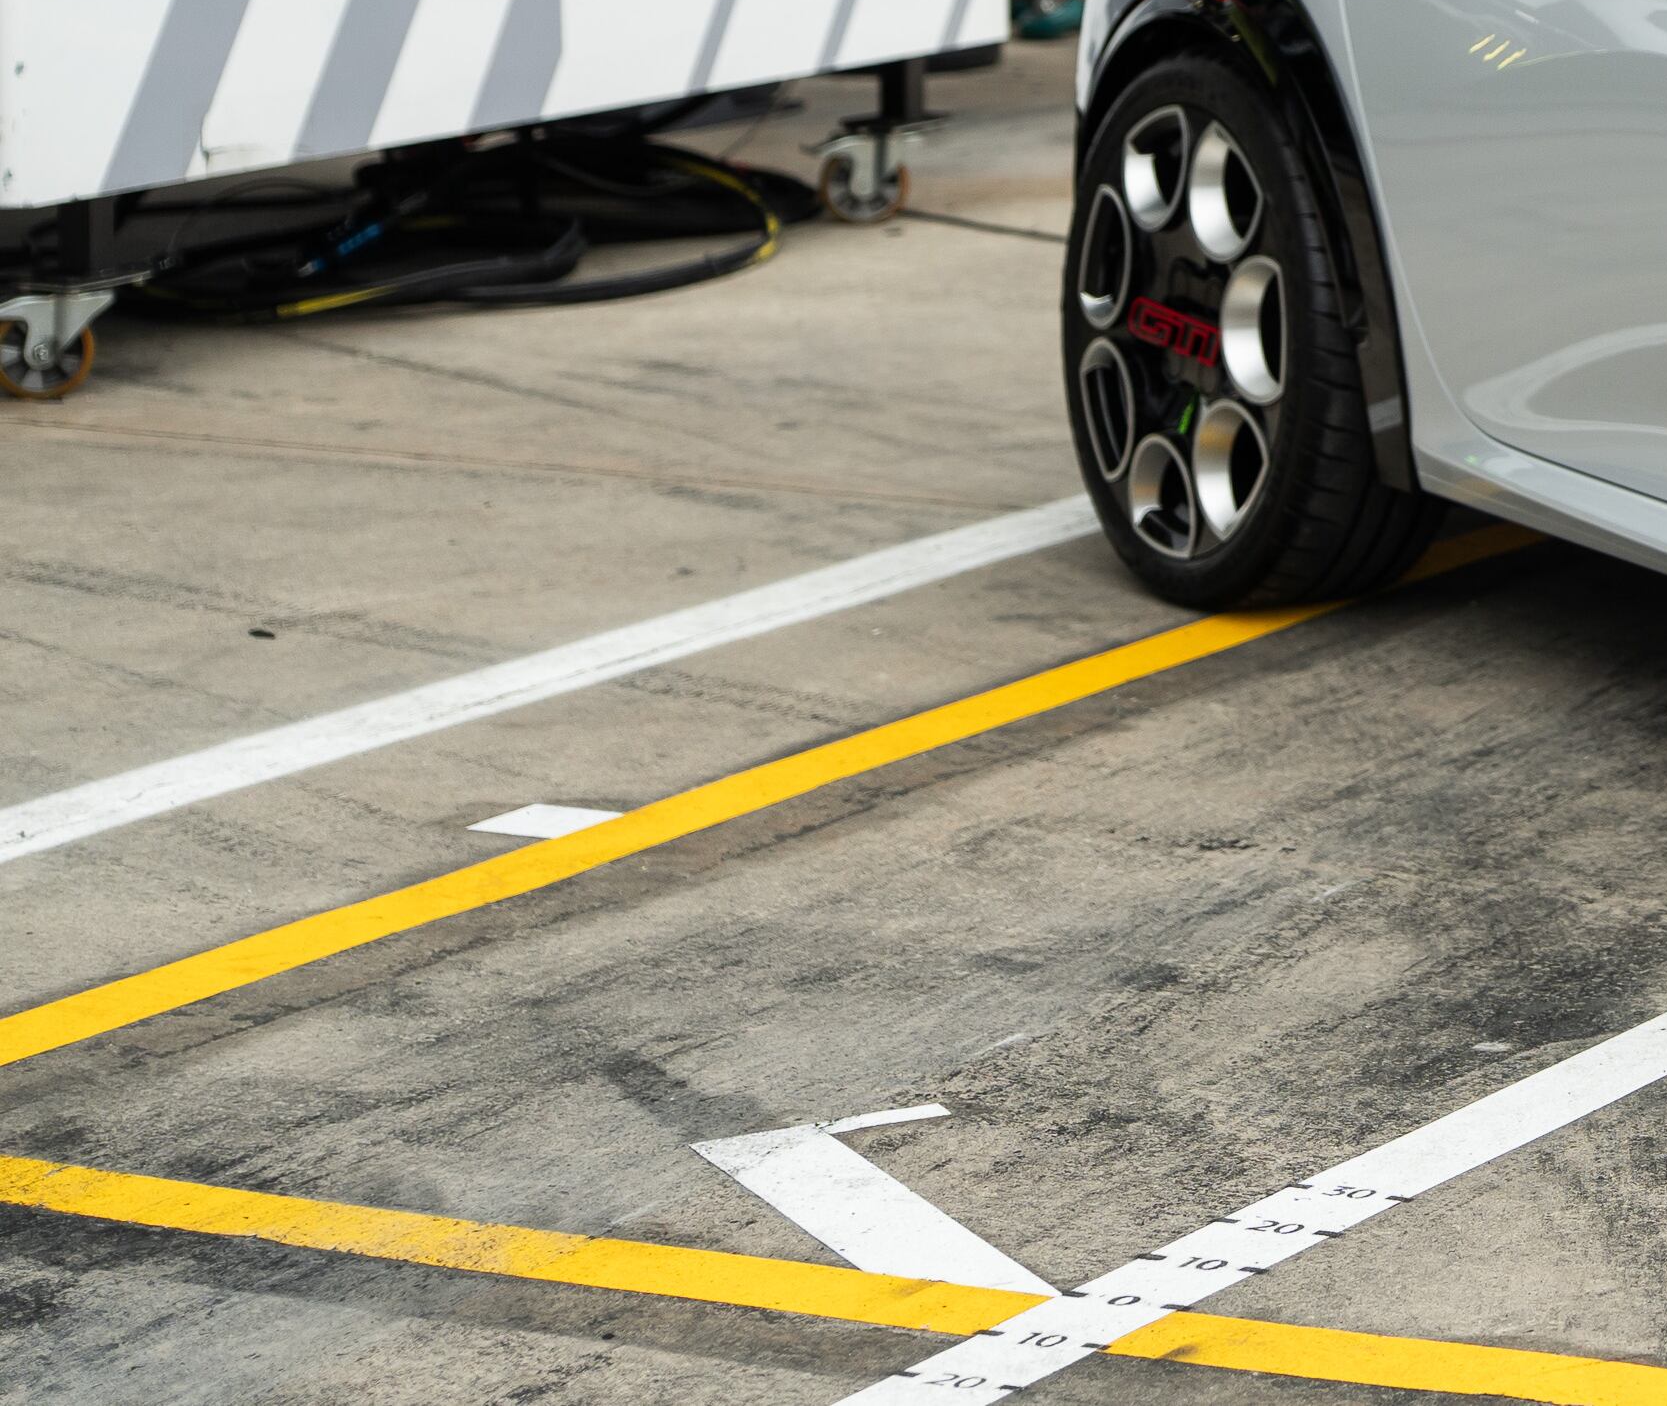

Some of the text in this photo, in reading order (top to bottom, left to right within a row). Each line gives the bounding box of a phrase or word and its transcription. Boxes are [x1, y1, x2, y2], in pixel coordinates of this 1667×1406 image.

[1321, 1185, 1377, 1200] 30
[1244, 1218, 1305, 1235] 20
[1177, 1255, 1229, 1272] 10
[1107, 1294, 1142, 1307] 0
[1016, 1331, 1068, 1348] 10
[929, 1372, 988, 1390] 20
